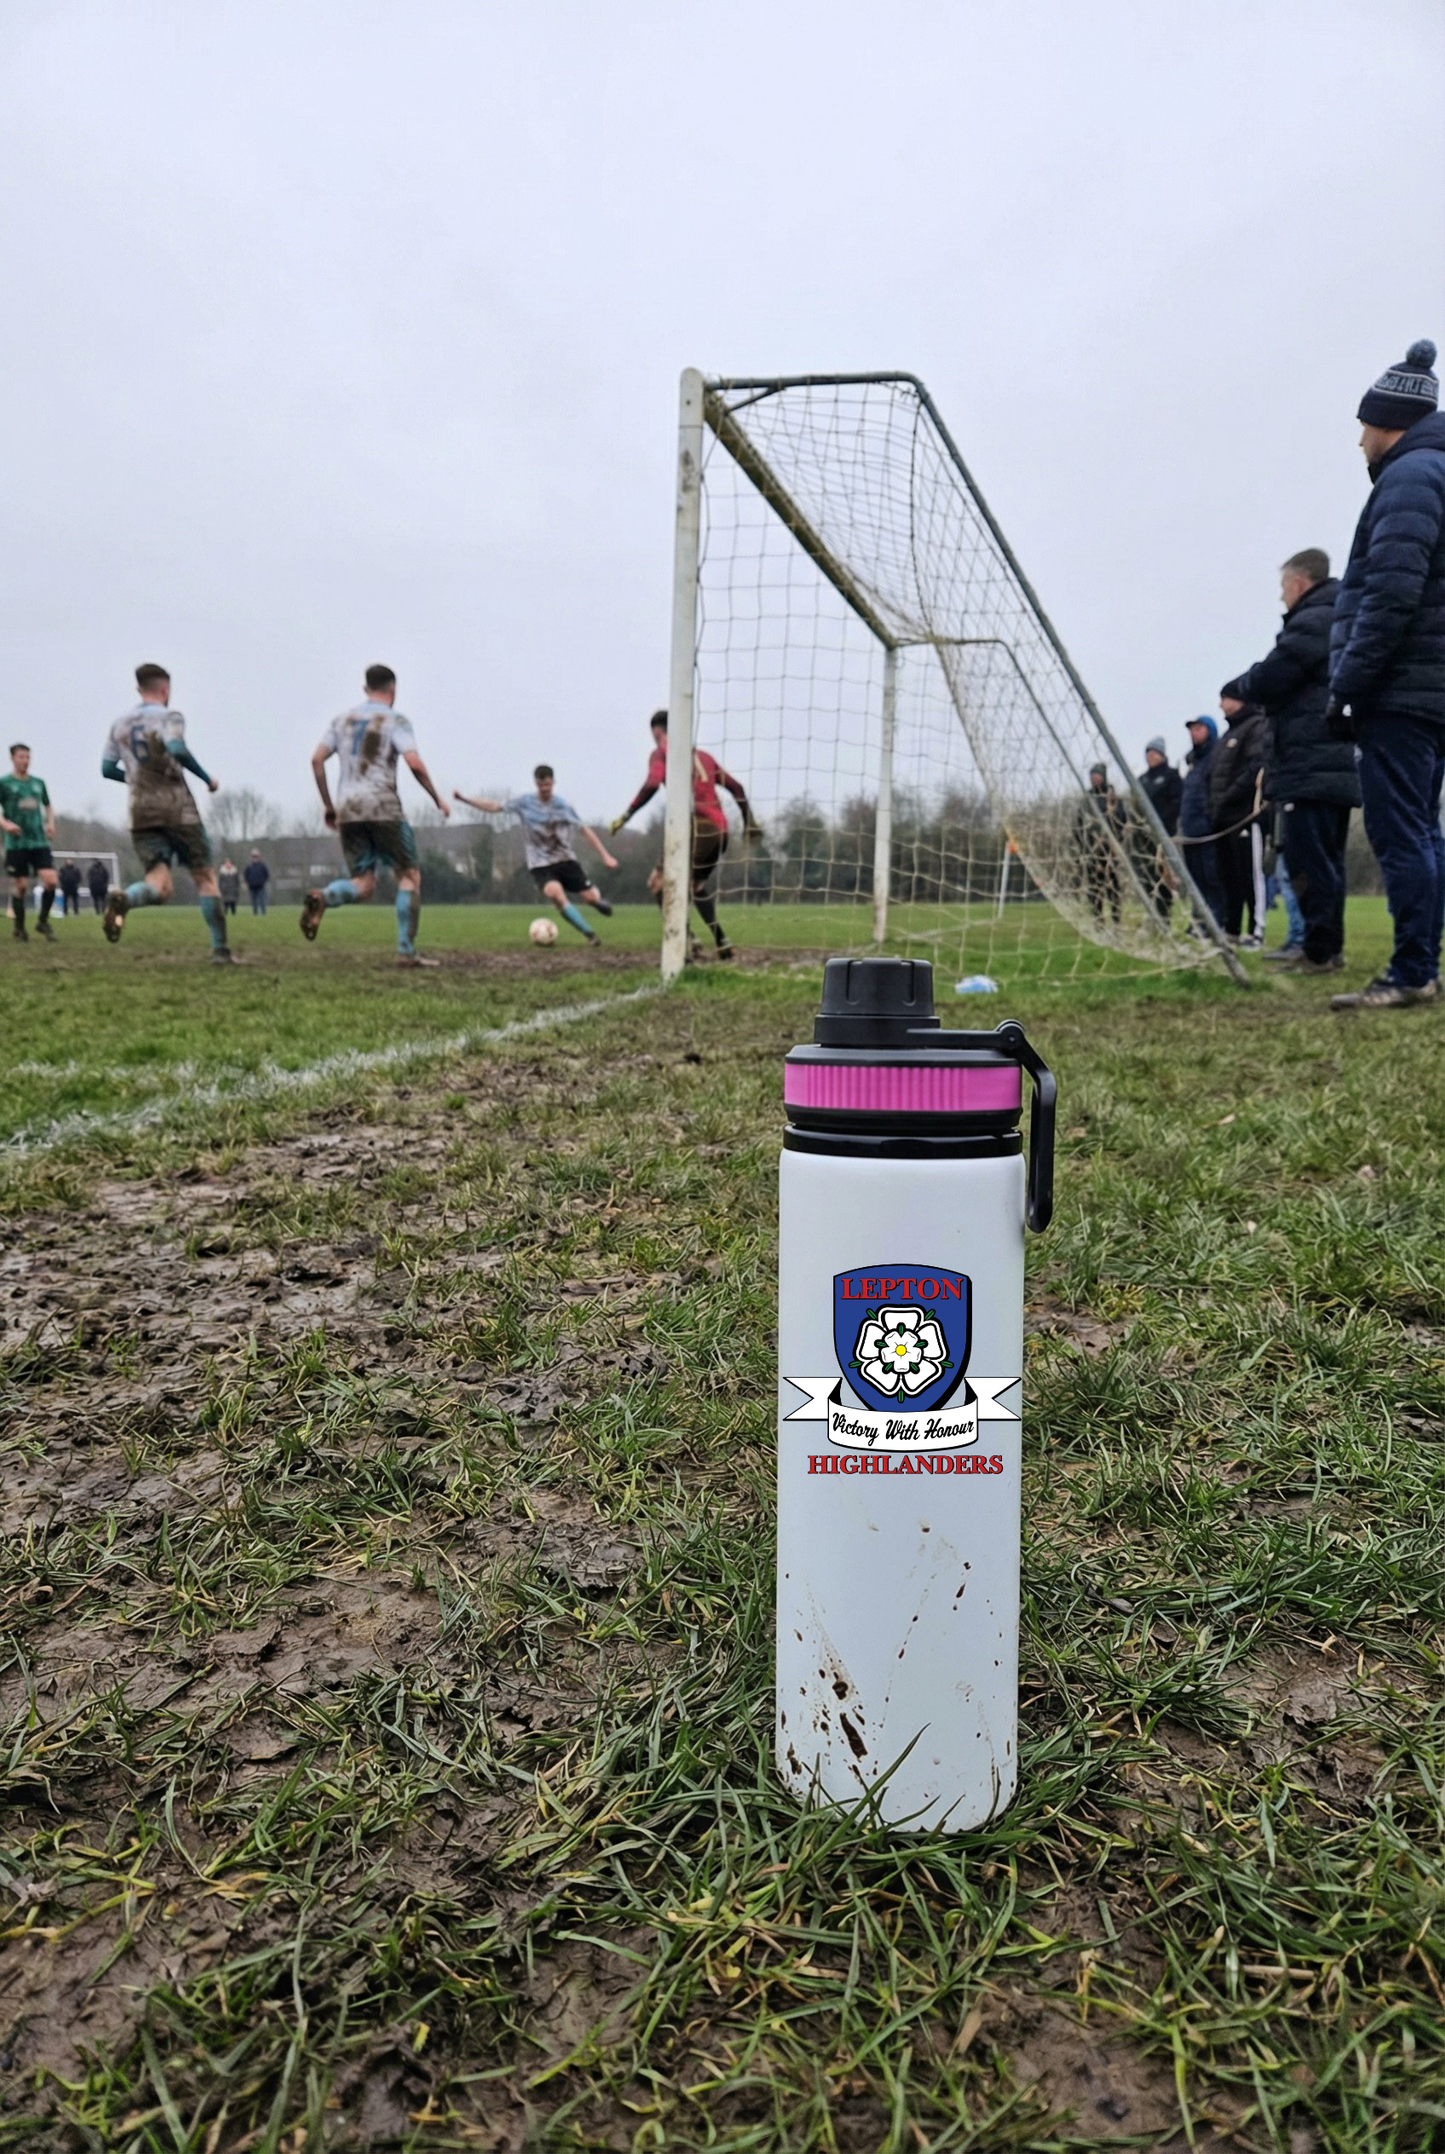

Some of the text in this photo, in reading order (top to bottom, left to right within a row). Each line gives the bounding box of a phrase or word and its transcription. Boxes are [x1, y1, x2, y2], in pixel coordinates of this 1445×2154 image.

[130, 724, 149, 764] 6
[841, 1278, 964, 1300] LEPTON
[832, 1412, 975, 1446] Victory With Honour
[807, 1455, 1004, 1475] HIGHLANDERS
